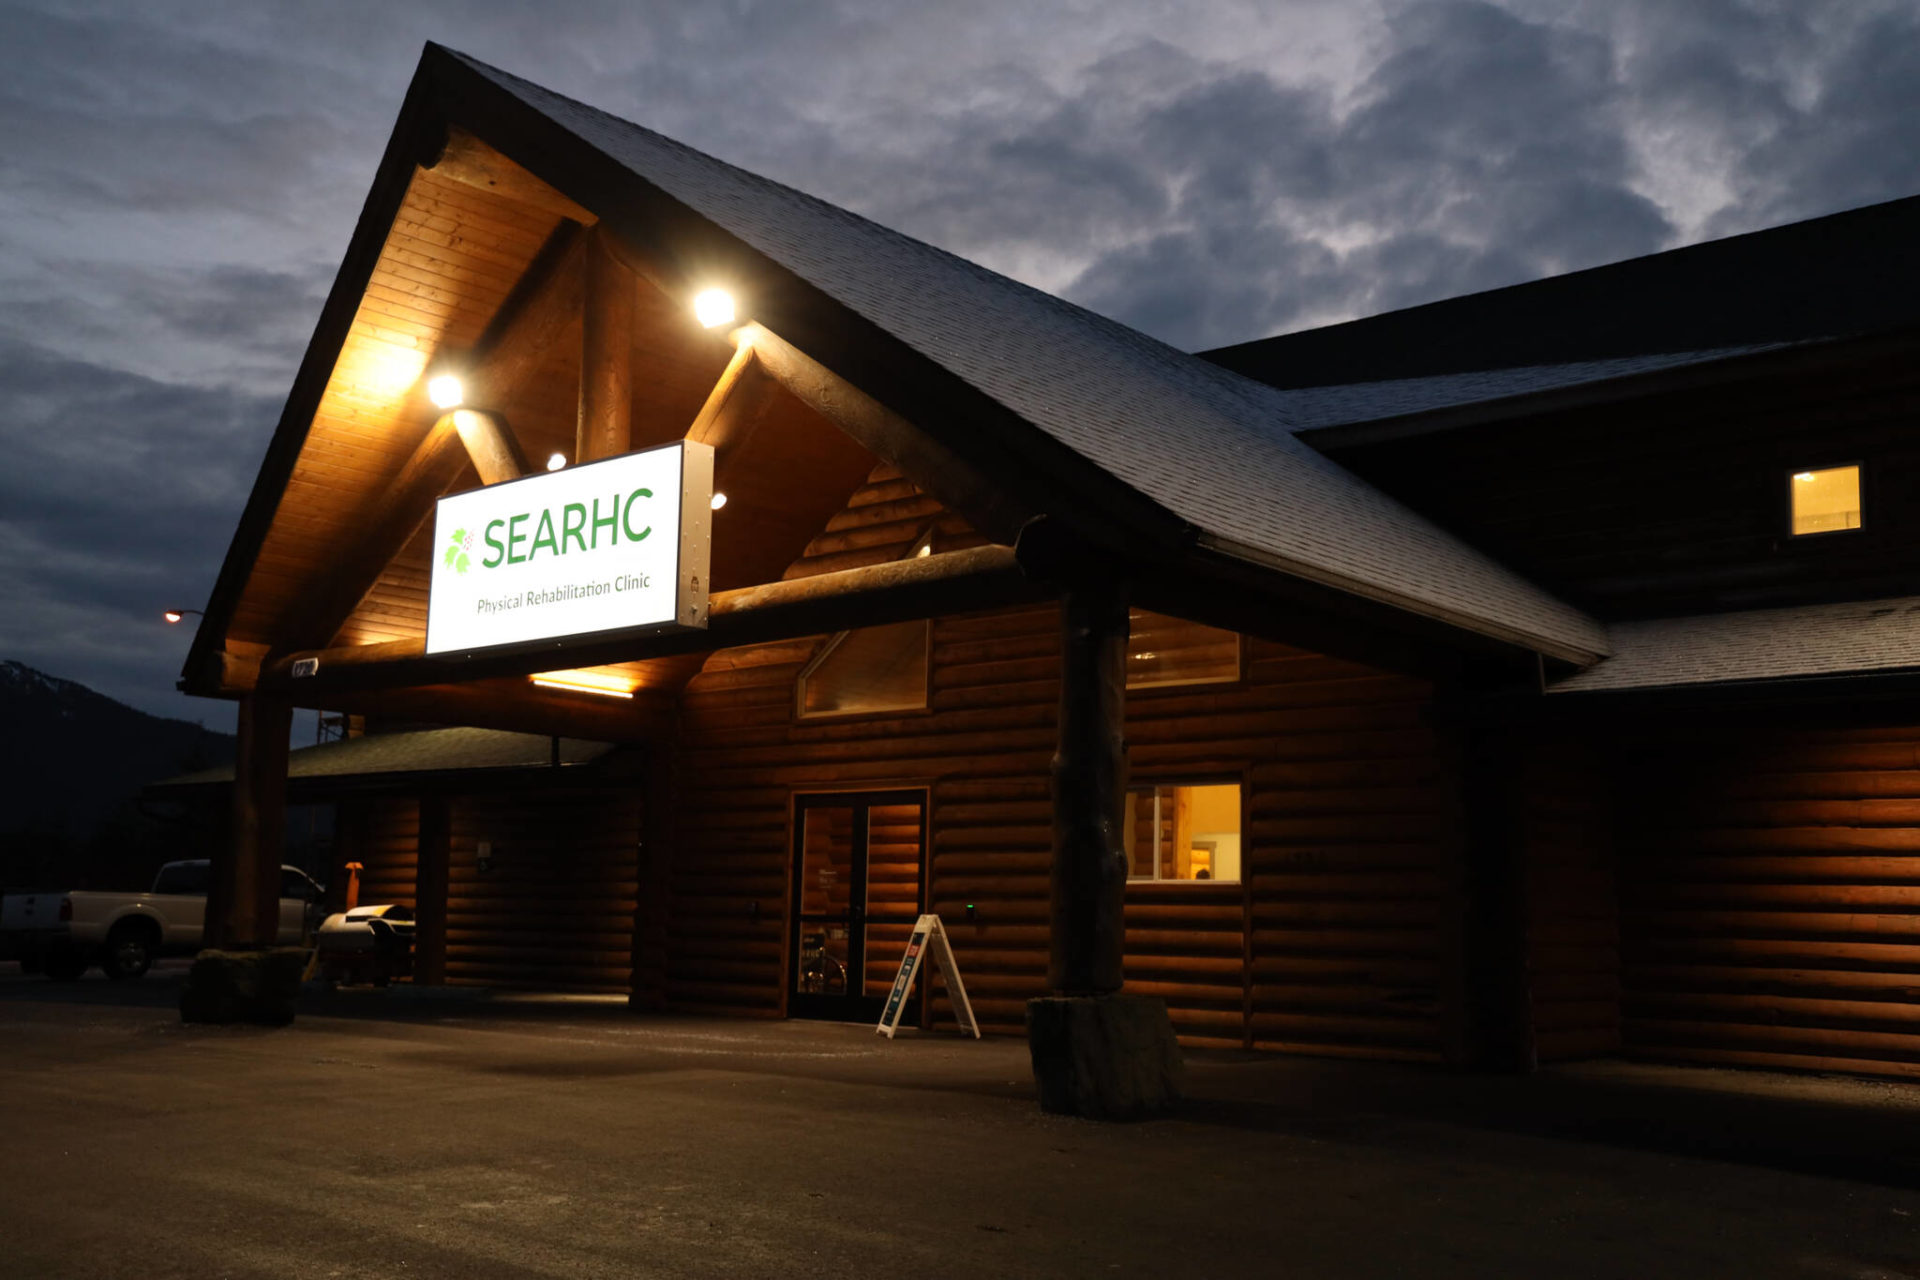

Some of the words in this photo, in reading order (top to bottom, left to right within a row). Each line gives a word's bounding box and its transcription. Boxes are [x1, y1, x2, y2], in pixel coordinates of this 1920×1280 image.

[481, 487, 654, 569] SEARHC
[477, 593, 523, 615] Physical
[526, 580, 611, 607] Rehabilitation
[614, 573, 651, 593] Clinic
